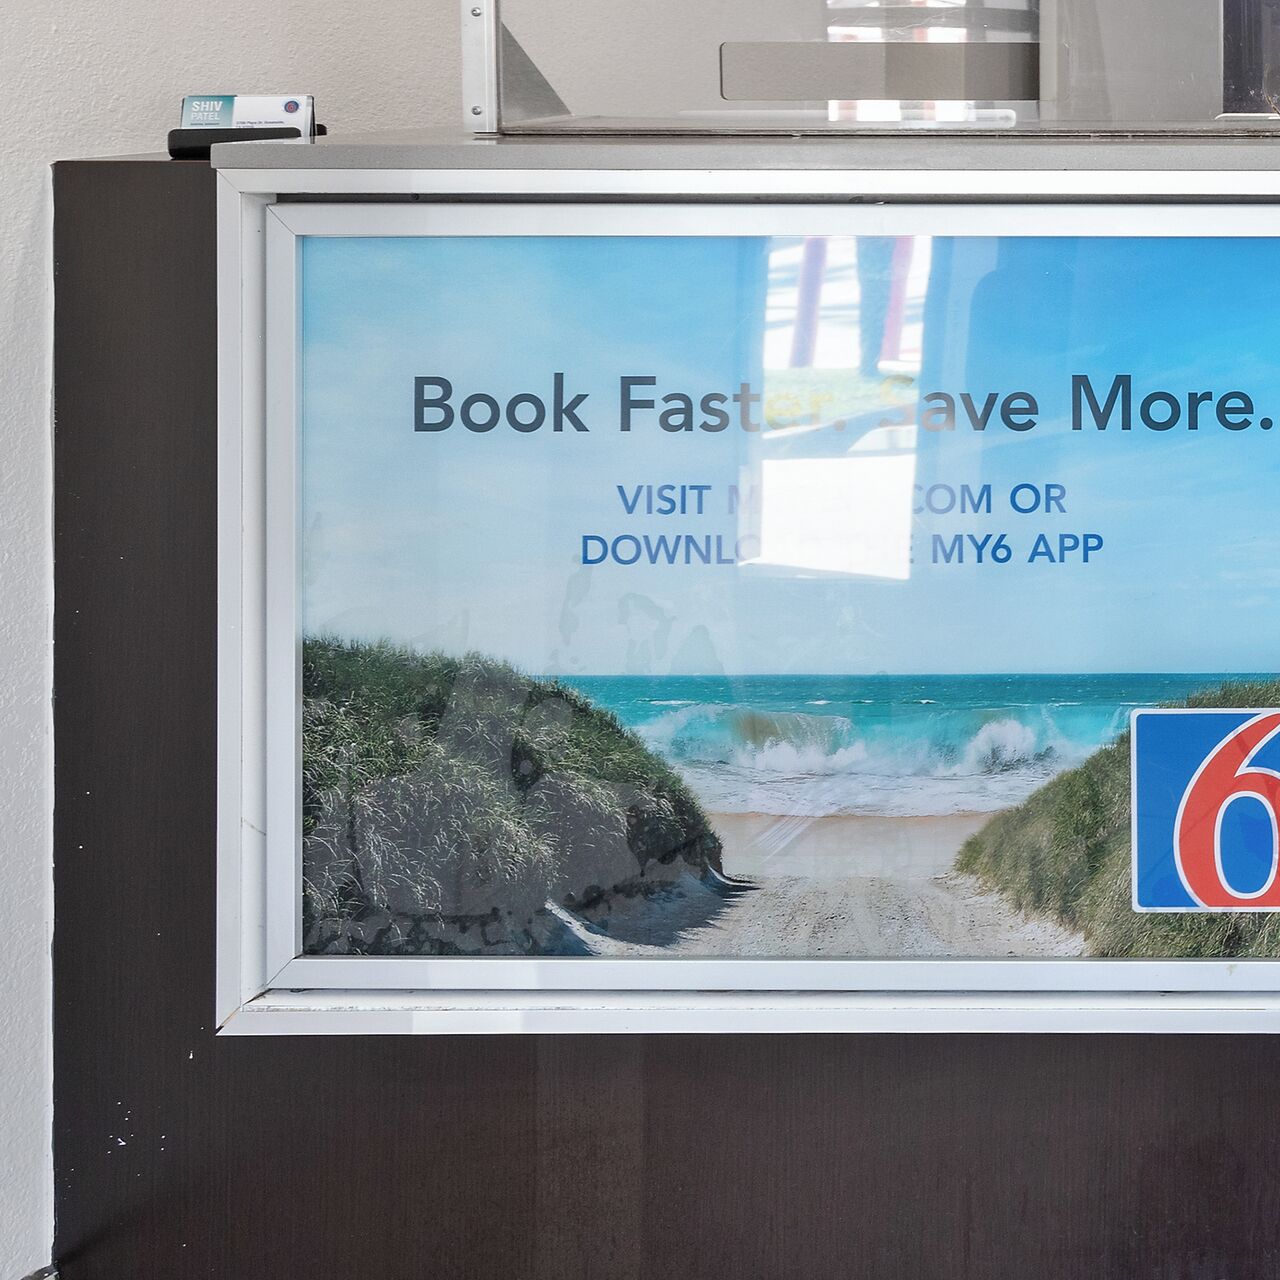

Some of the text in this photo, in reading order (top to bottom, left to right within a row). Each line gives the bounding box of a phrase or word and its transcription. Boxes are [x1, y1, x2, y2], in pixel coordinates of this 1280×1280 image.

[190, 112, 220, 120] PATEL
[192, 100, 223, 112] SHIV
[413, 372, 590, 433] Book
[1071, 373, 1275, 432] More.
[616, 484, 712, 515] VISIT
[1009, 483, 1067, 514] OR
[932, 533, 1012, 564] MY6
[1028, 533, 1104, 564] APP
